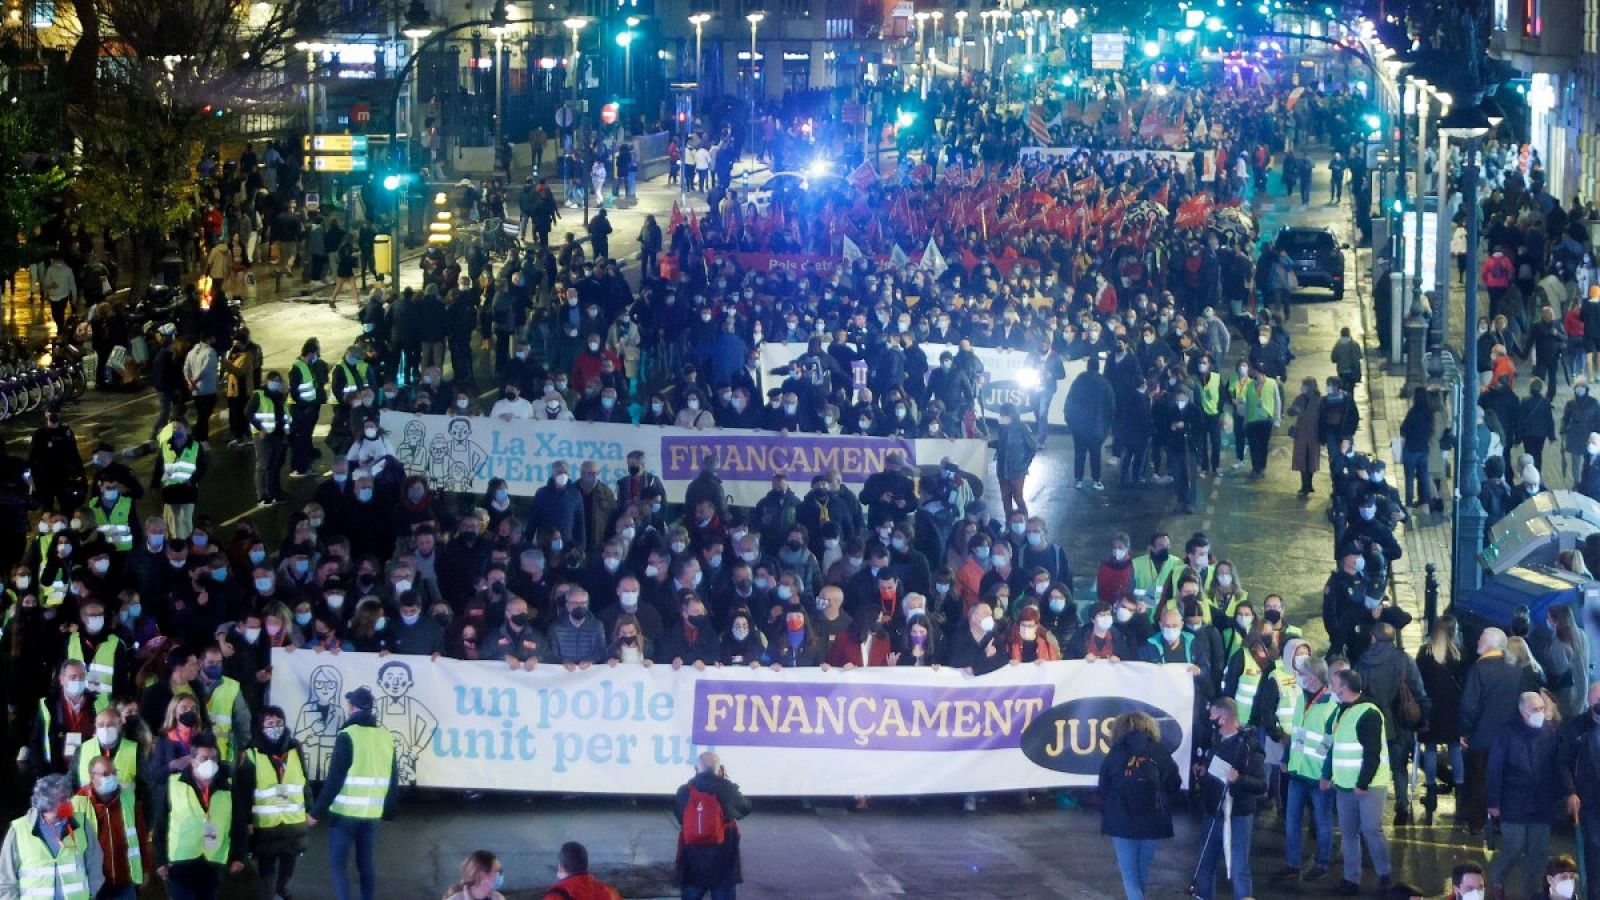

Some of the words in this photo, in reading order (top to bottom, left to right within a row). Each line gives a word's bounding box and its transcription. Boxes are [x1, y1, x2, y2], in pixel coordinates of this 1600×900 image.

[491, 430, 527, 456] La
[534, 432, 625, 460] Xarxa
[453, 684, 520, 718] un
[537, 680, 675, 729] poble
[704, 692, 1044, 746] FINANÇAMENT
[431, 720, 537, 760] unit
[552, 731, 638, 773] per
